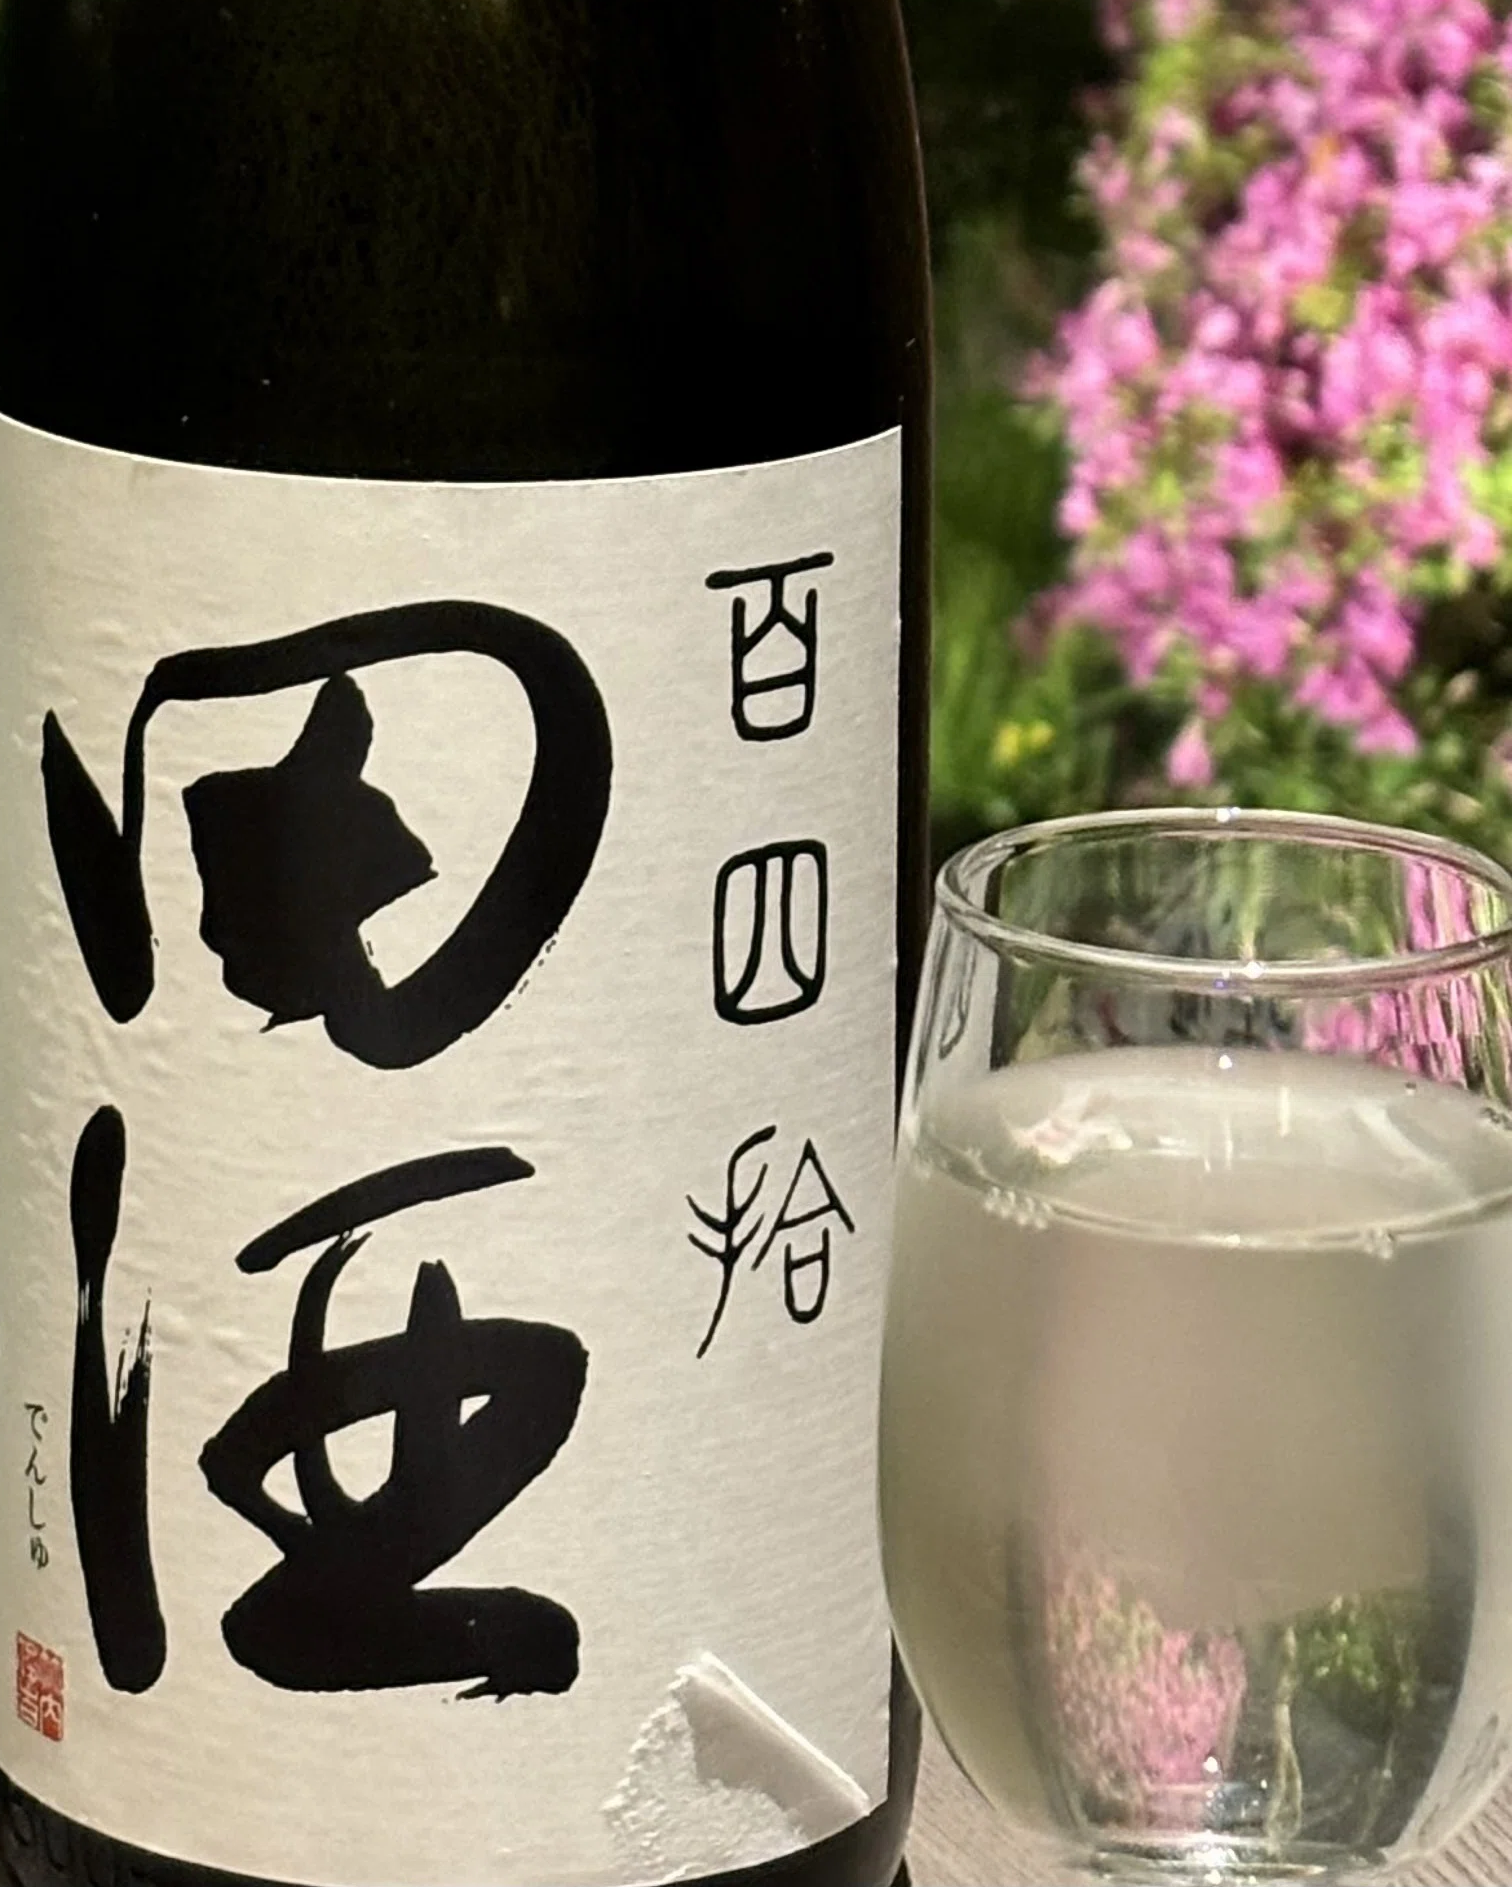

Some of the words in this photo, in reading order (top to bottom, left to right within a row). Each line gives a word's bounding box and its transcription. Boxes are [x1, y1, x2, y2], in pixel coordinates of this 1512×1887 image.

[43, 601, 612, 1701] 田酒
[687, 552, 855, 1359] 百四拾
[24, 1403, 49, 1570] でんしゅ
